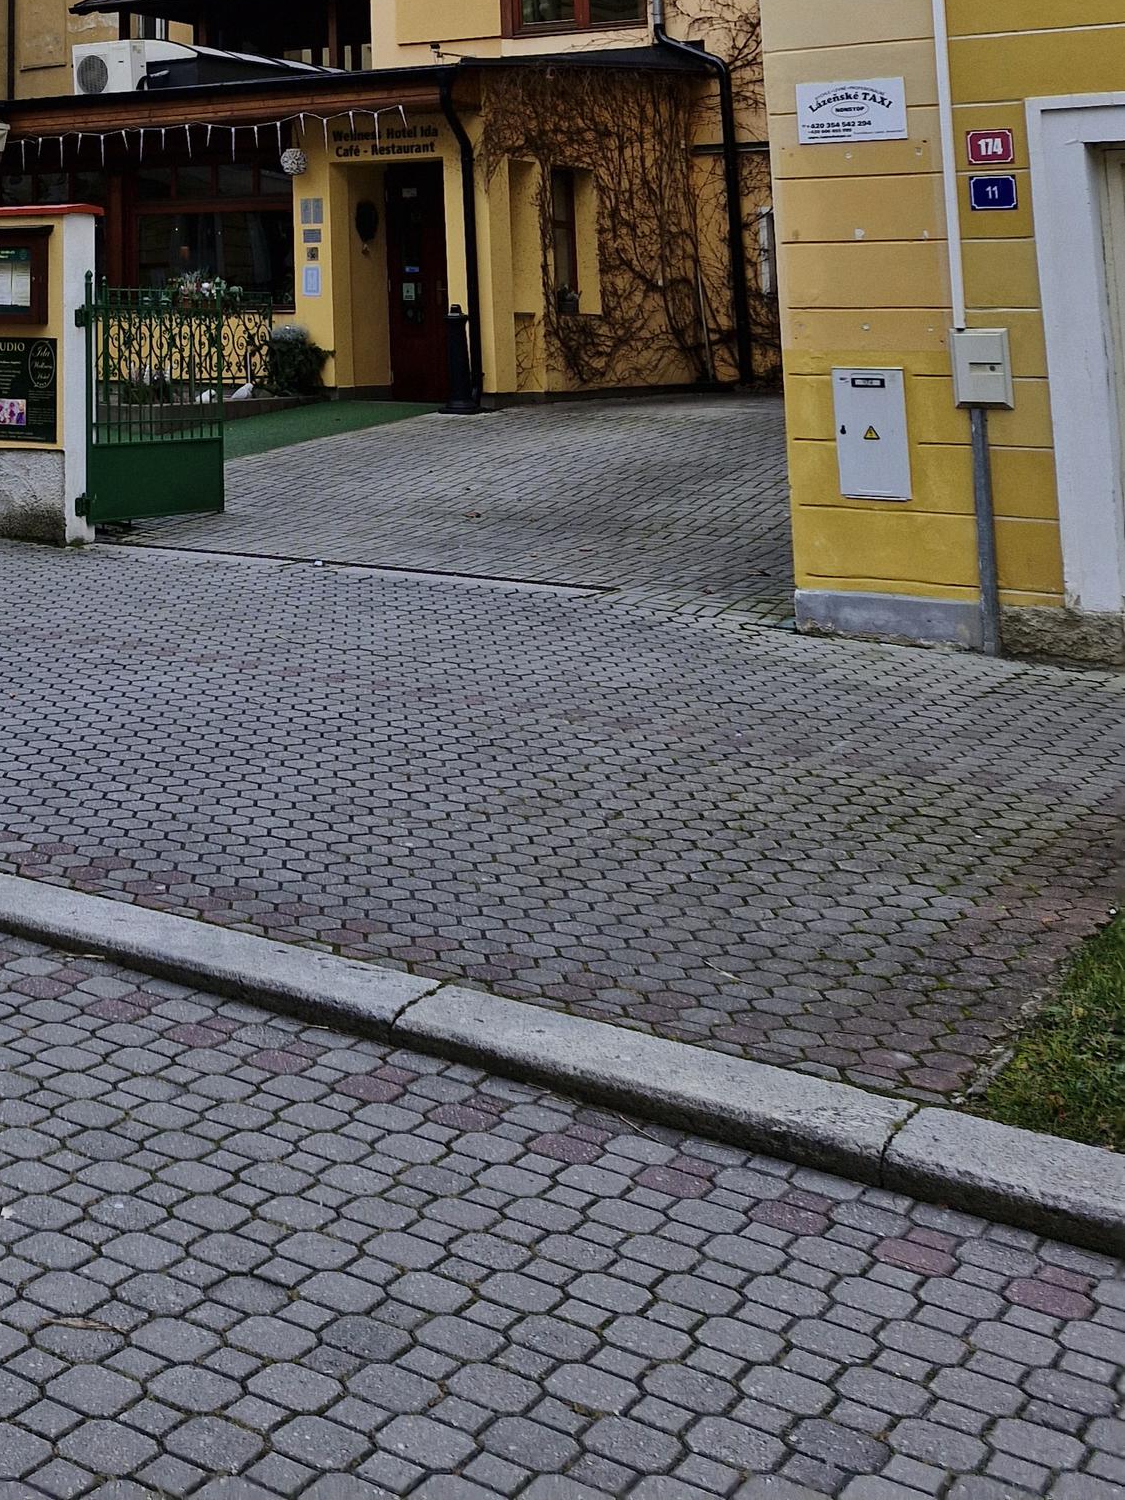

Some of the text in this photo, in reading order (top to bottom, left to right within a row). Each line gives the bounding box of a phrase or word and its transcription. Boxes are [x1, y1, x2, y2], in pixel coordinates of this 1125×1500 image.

[808, 91, 893, 113] Lázeňské TAXI
[386, 126, 417, 139] Hotel
[420, 125, 438, 138] Ida
[336, 145, 360, 157] Café
[371, 142, 435, 155] Restaurant
[977, 138, 1003, 156] 174
[985, 186, 998, 199] 11
